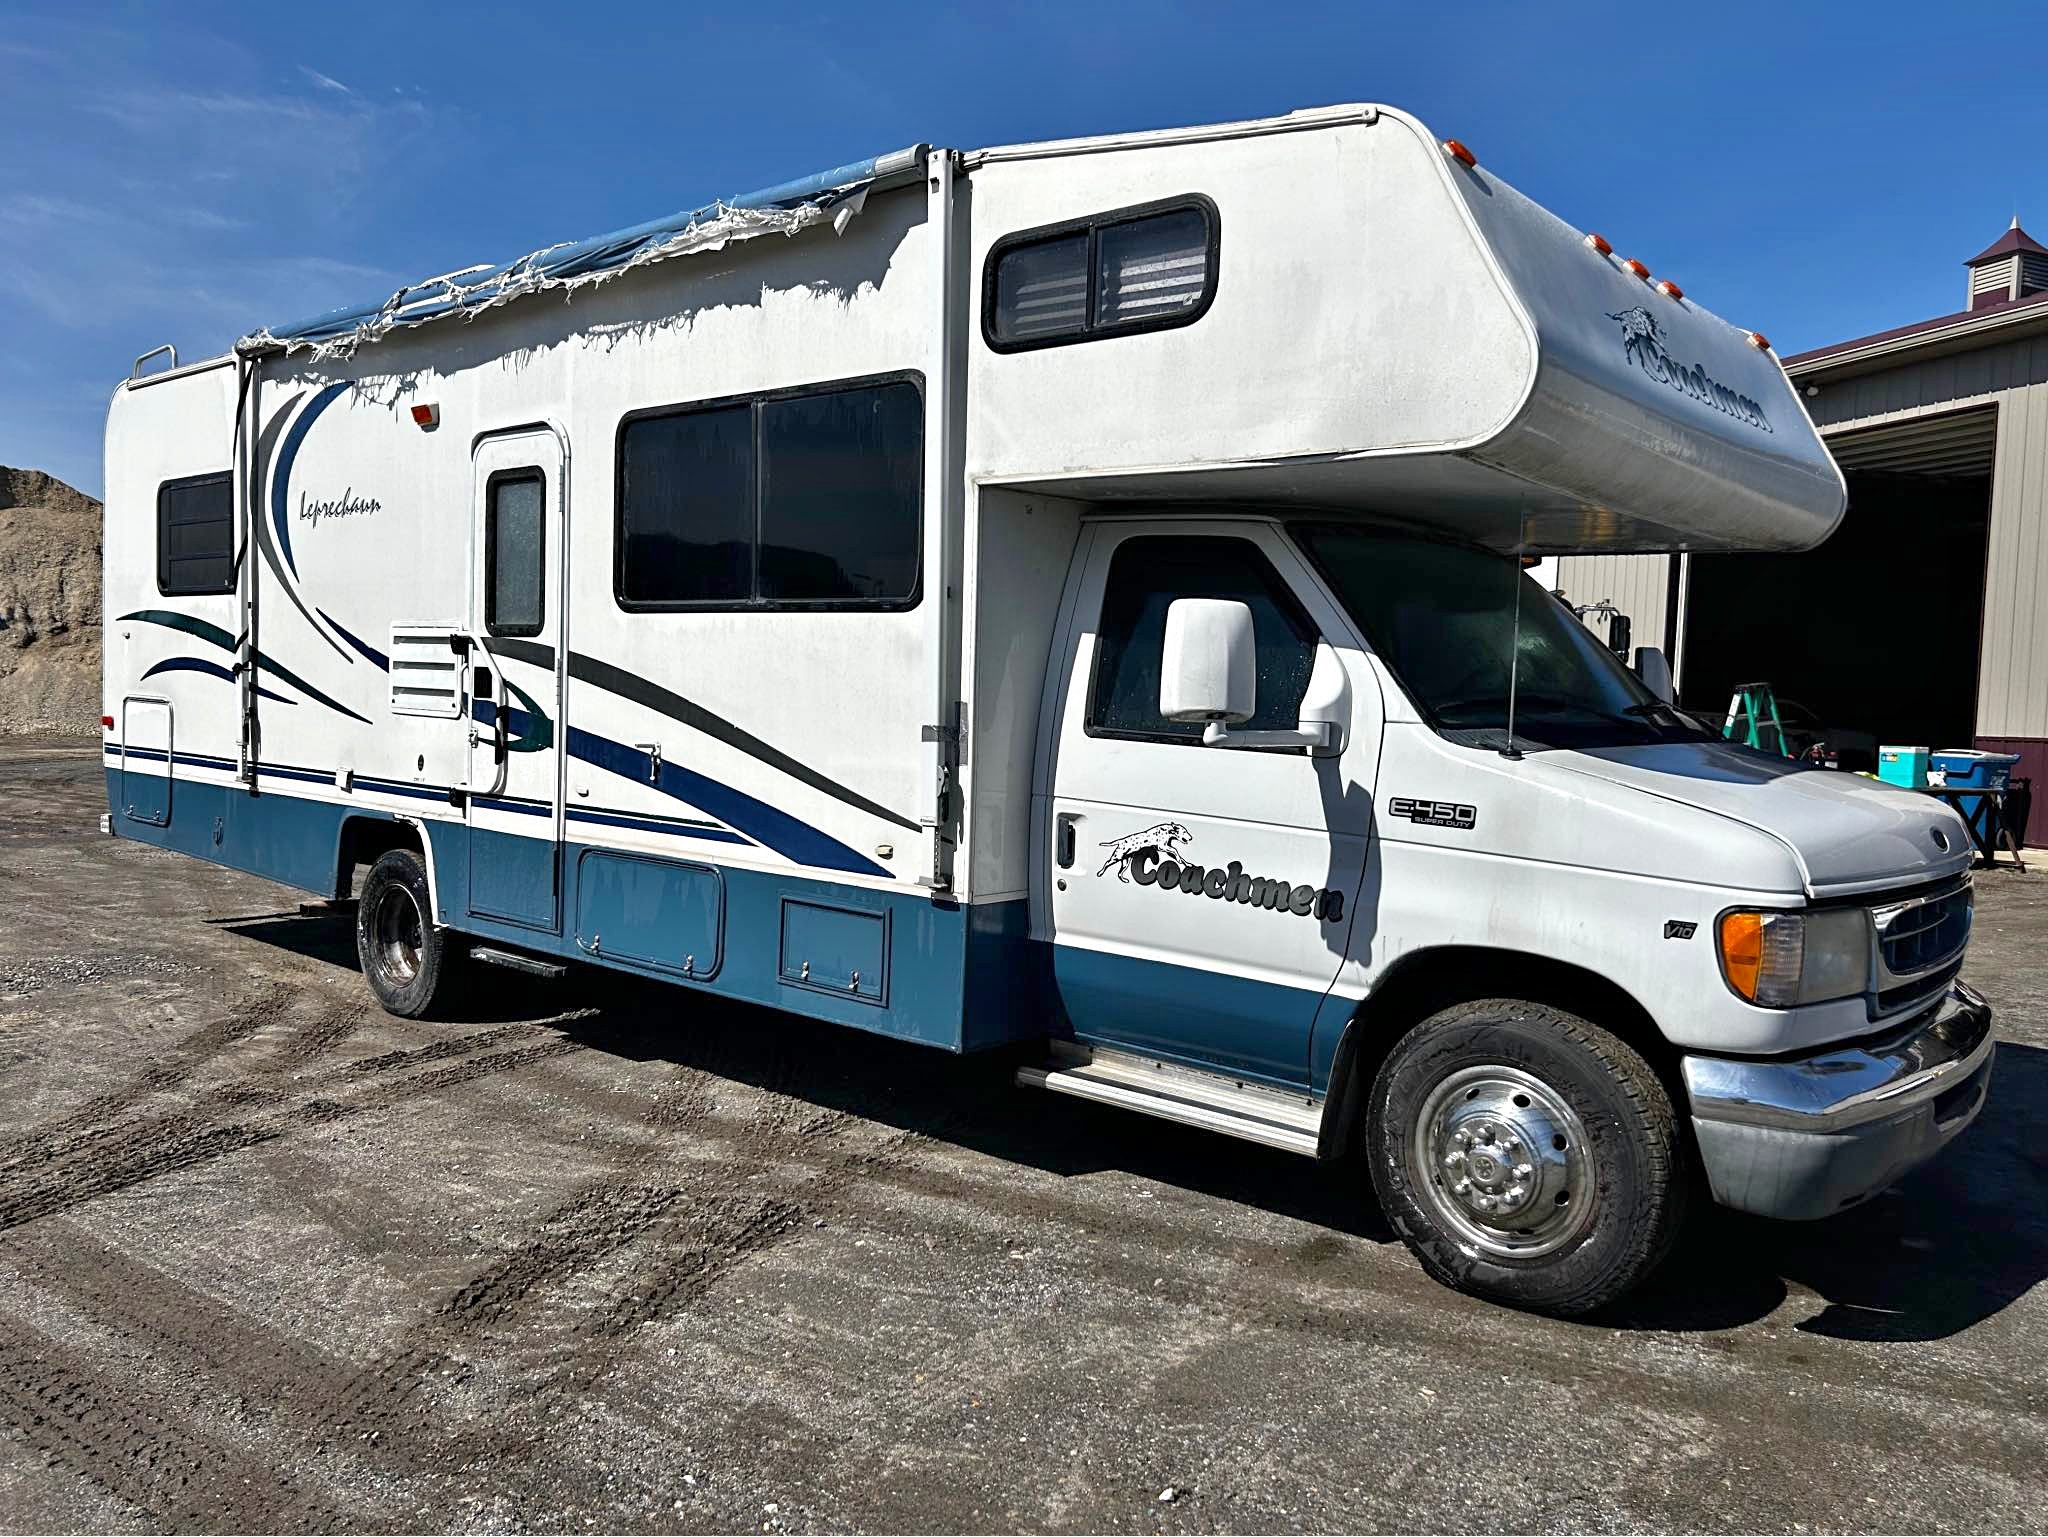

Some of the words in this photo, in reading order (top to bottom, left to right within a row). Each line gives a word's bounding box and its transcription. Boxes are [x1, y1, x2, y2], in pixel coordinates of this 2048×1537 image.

[299, 486, 382, 529] Leprechaun
[1414, 815, 1444, 826] SUPER
[1445, 819, 1471, 828] DUTY
[1130, 846, 1345, 923] Coachmen
[1665, 924, 1694, 938] V10
